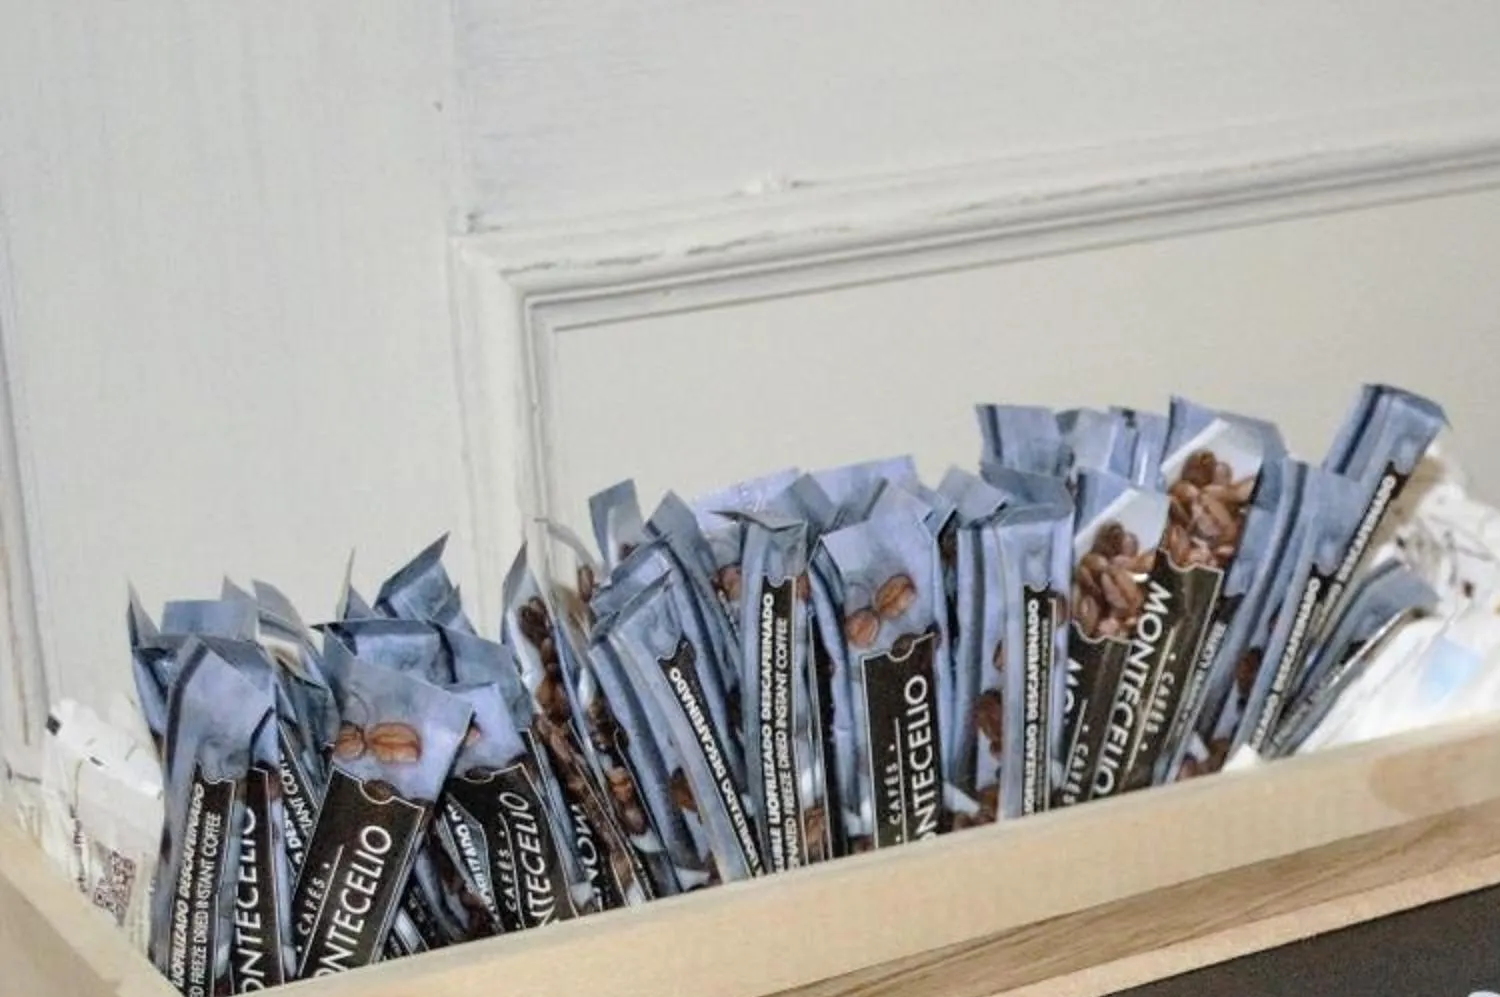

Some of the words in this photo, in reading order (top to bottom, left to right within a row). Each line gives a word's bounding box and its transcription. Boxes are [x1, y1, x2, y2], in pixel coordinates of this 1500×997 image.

[668, 667, 727, 781] DESCAFEINADO
[761, 593, 774, 719] DESCAFEINADO
[1095, 580, 1172, 795] MONTECELIO
[904, 675, 938, 839] NTECELIO
[203, 811, 221, 857] COFFEE
[235, 807, 265, 994] ONTECELIO
[314, 825, 392, 976] NTECELIO
[499, 792, 556, 927] NTECELIO
